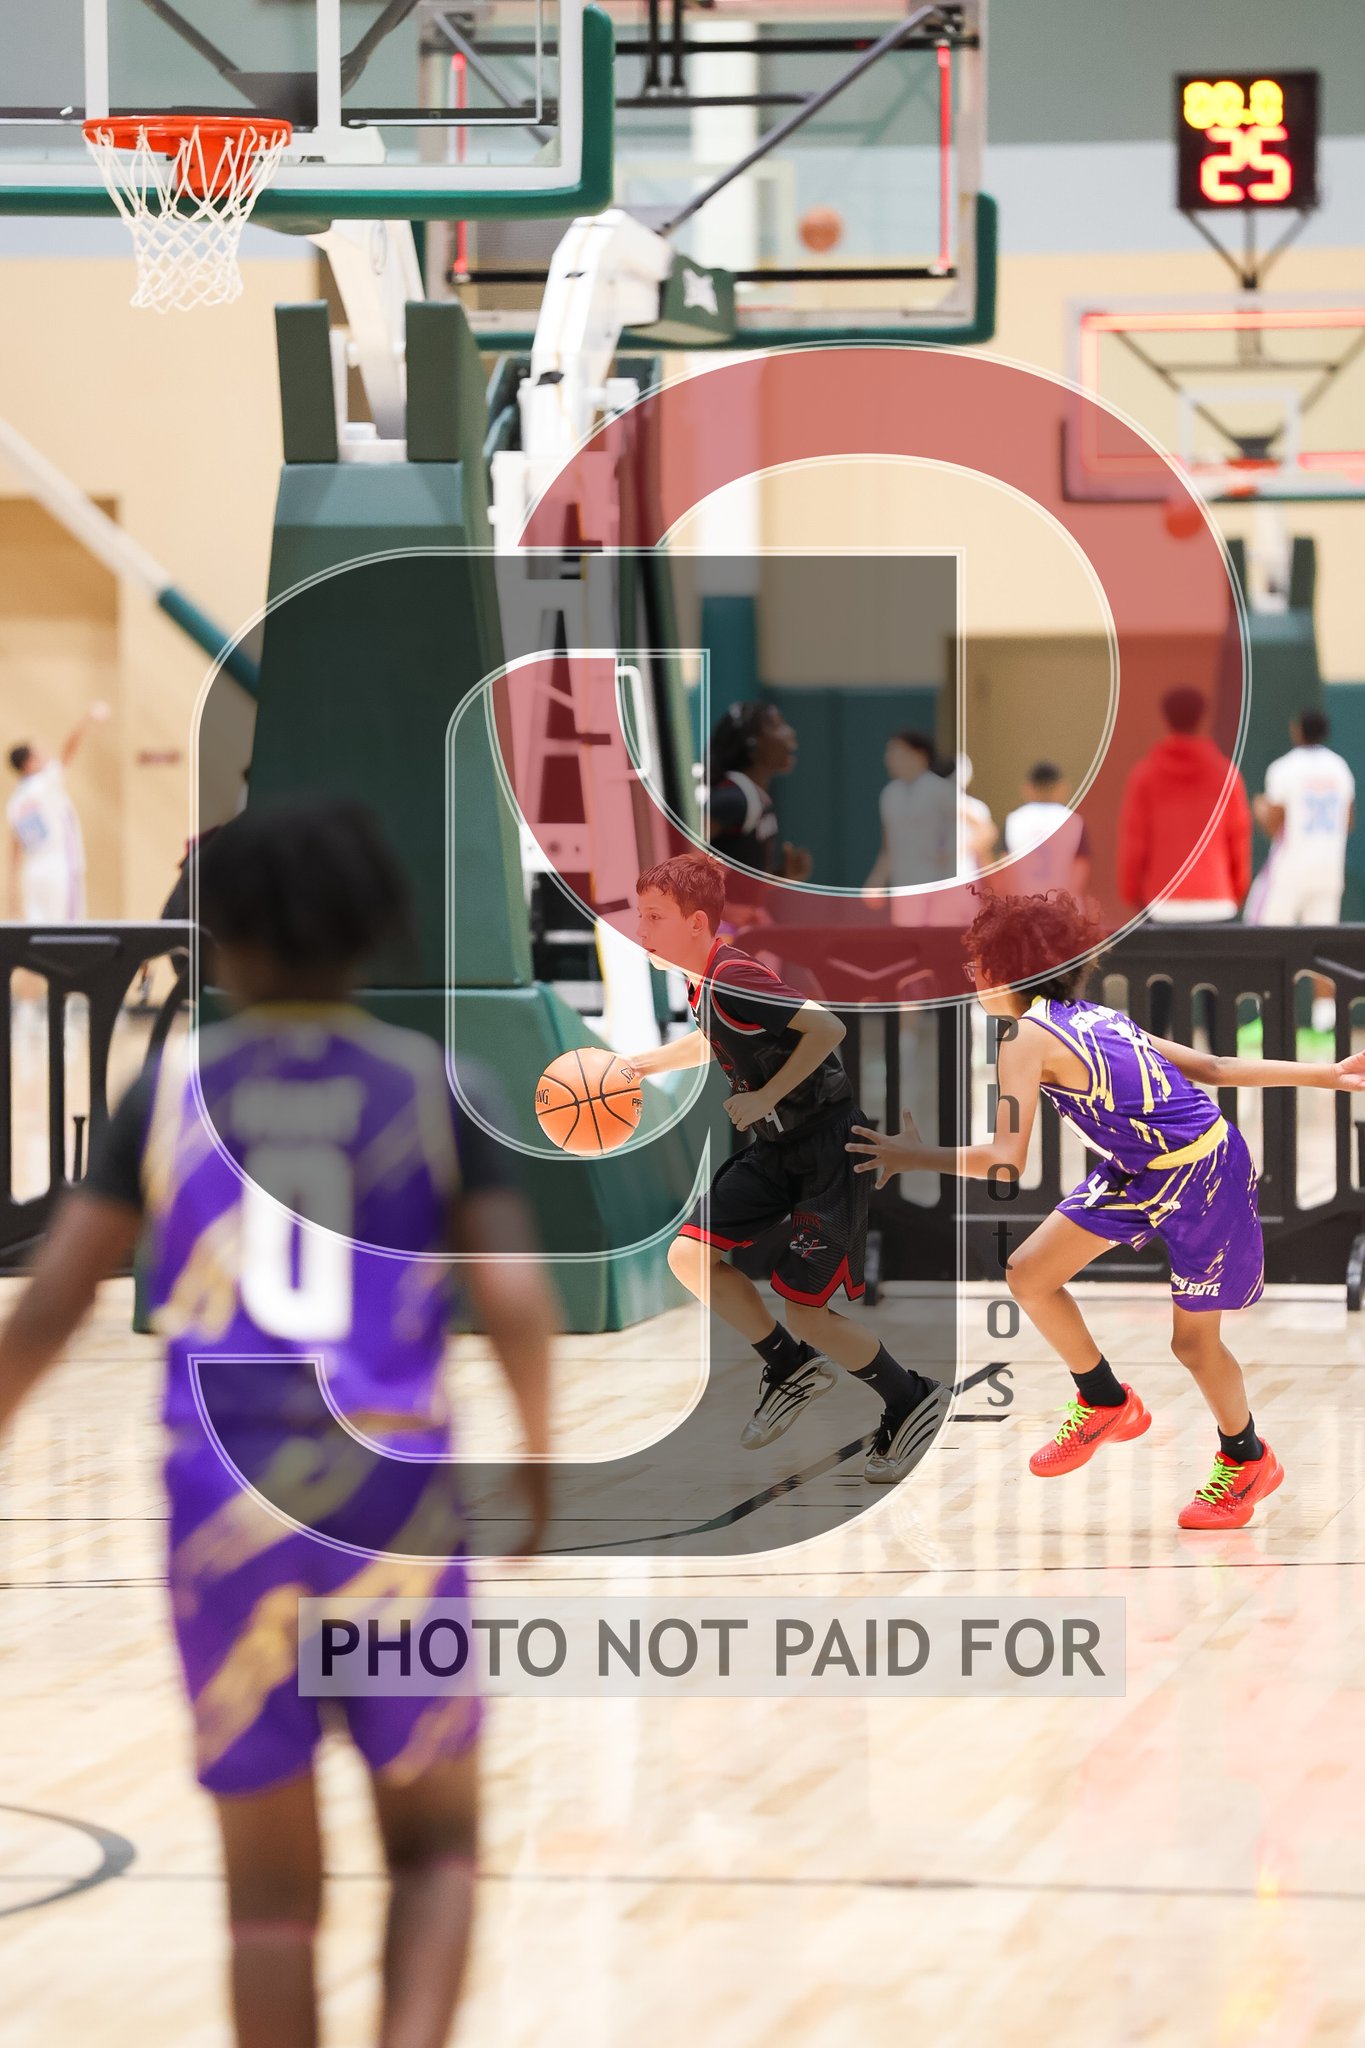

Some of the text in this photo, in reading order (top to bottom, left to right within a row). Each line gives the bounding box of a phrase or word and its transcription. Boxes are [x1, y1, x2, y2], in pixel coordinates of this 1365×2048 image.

[1201, 126, 1292, 202] 25
[1084, 1173, 1109, 1208] 4
[1186, 1282, 1222, 1297] ELITE
